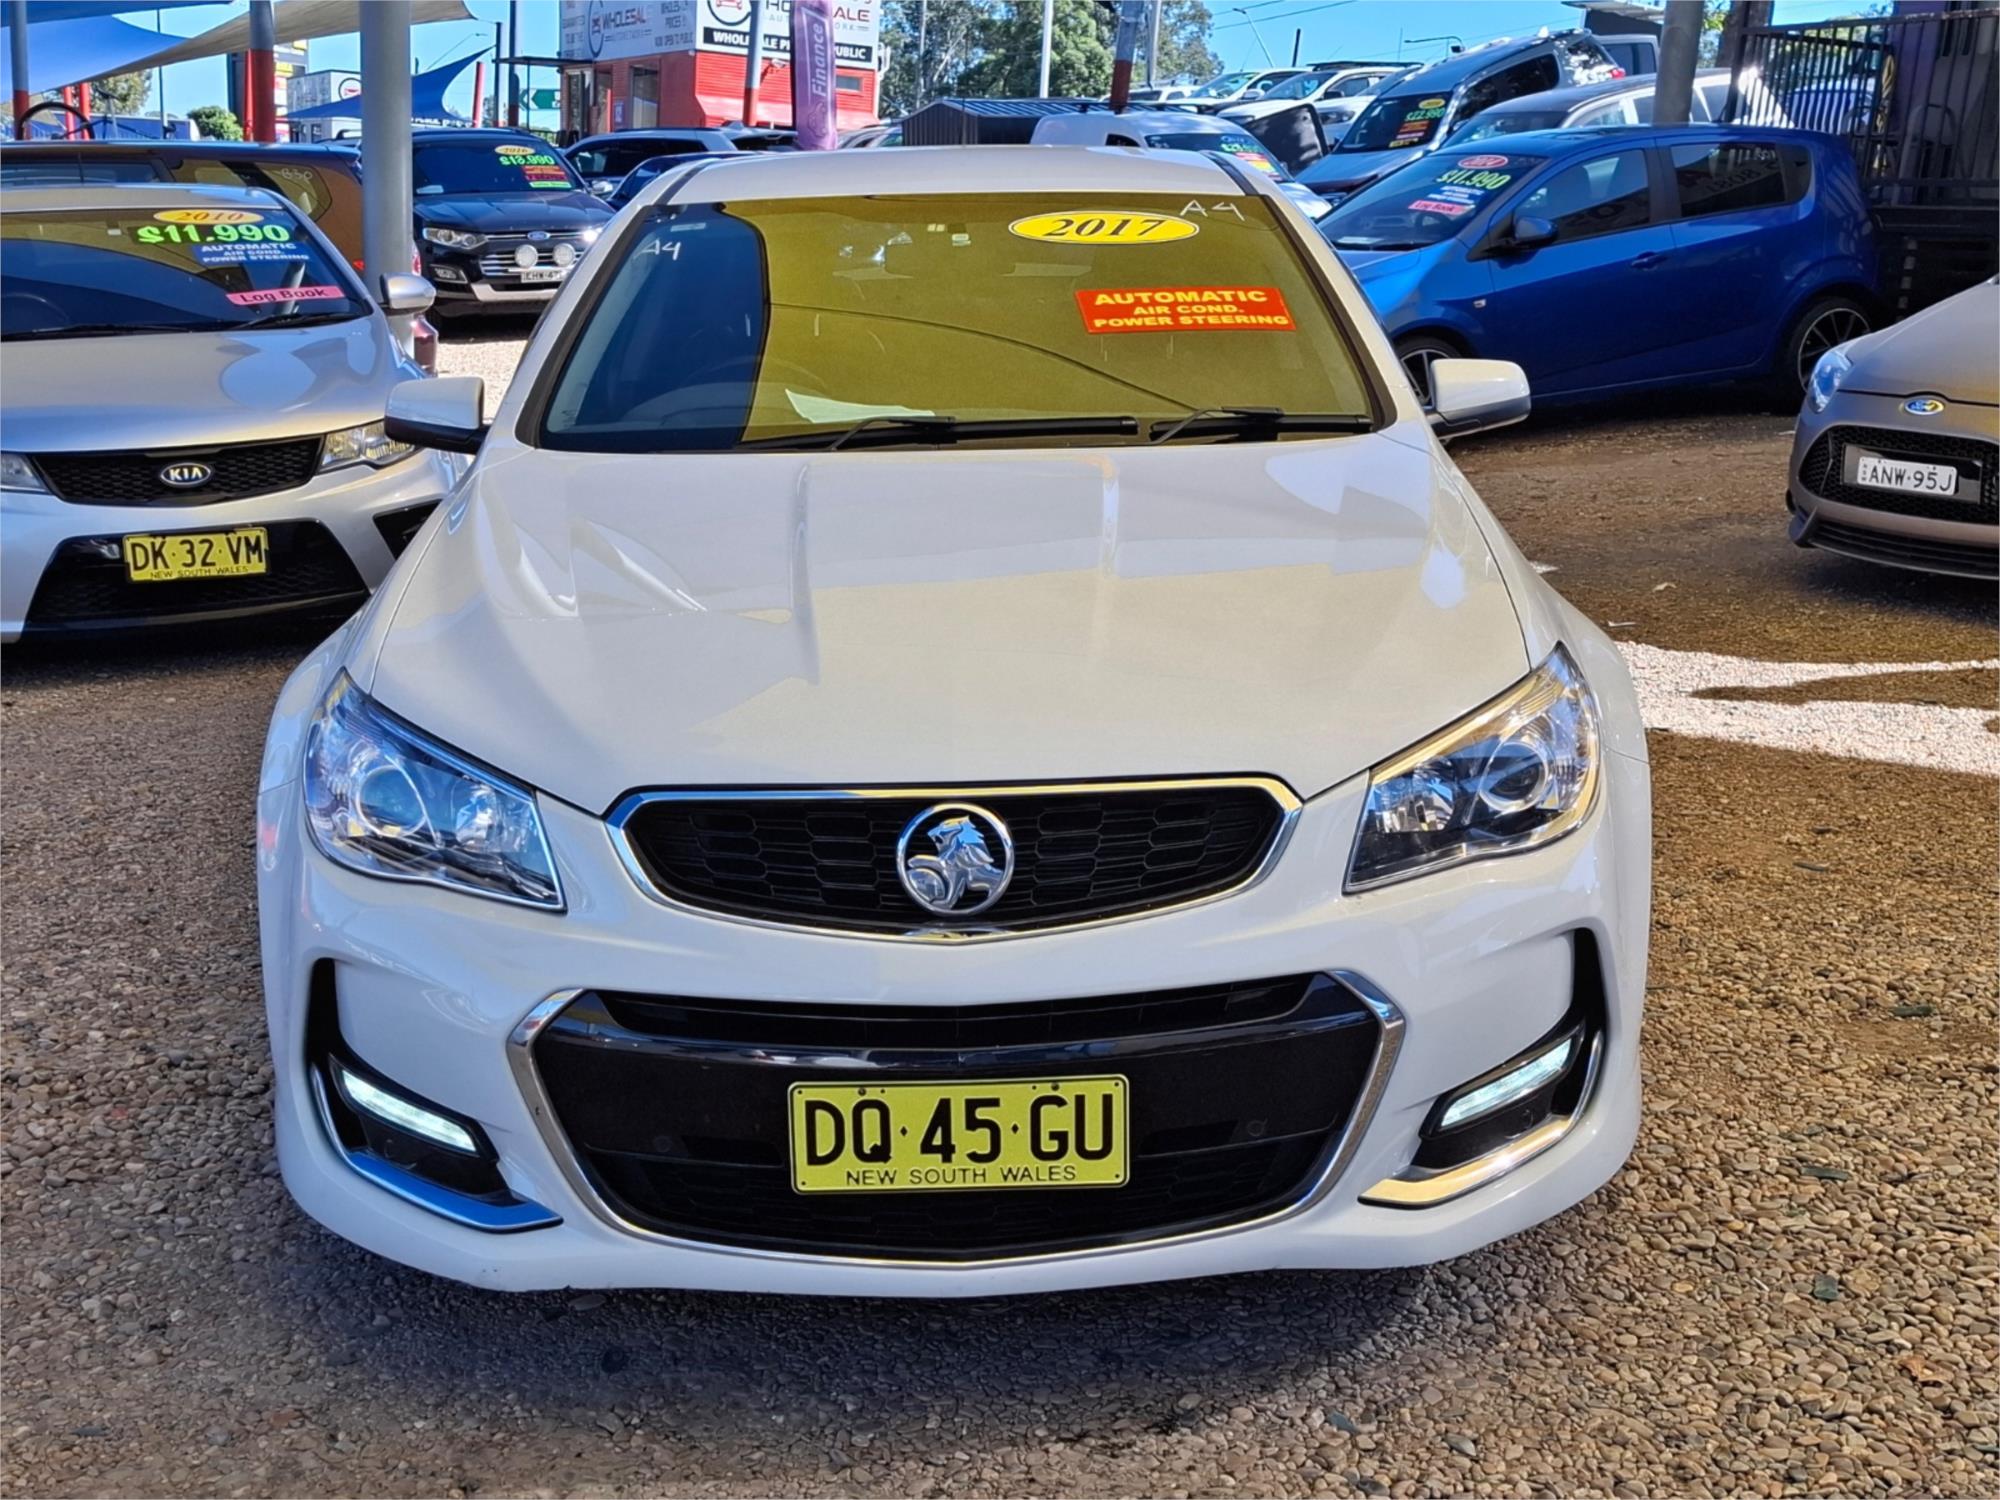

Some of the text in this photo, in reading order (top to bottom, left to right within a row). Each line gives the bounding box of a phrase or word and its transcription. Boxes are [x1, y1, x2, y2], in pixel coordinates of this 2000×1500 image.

[812, 23, 827, 97] Finance
[177, 211, 245, 222] 2010
[1180, 199, 1245, 222] A4
[137, 224, 290, 244] $11.990
[1043, 218, 1165, 237] 2017
[201, 243, 296, 253] AUTOMATIC
[633, 238, 681, 260] A4
[203, 253, 310, 263] POWER STEERING
[240, 288, 329, 304] Log Book
[1095, 290, 1268, 306] AUTOMATIC
[1133, 303, 1245, 315] AIR COND.
[1093, 314, 1289, 328] POWER STEERING
[168, 467, 203, 481] KIA
[151, 566, 248, 579] NEW SOUTH WALES
[846, 1165, 1076, 1185] NEW SOUTH WALES
